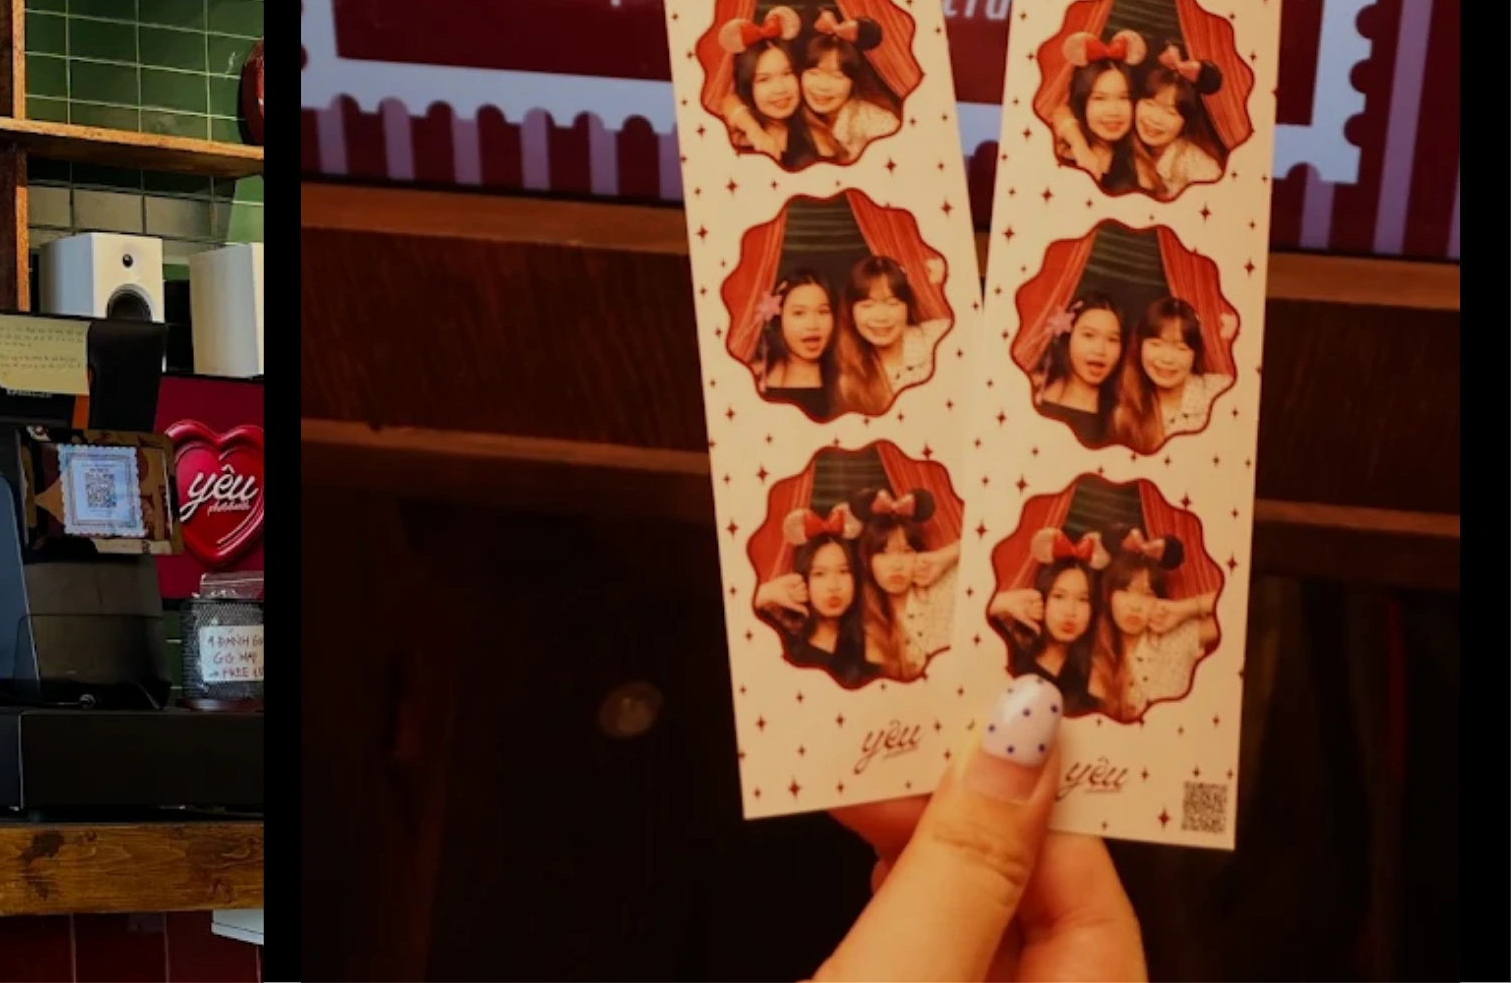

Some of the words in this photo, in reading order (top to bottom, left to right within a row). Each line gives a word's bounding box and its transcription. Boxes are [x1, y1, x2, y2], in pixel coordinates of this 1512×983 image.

[179, 464, 259, 522] yêu
[853, 720, 921, 775] yêu
[1056, 757, 1130, 802] yêu
